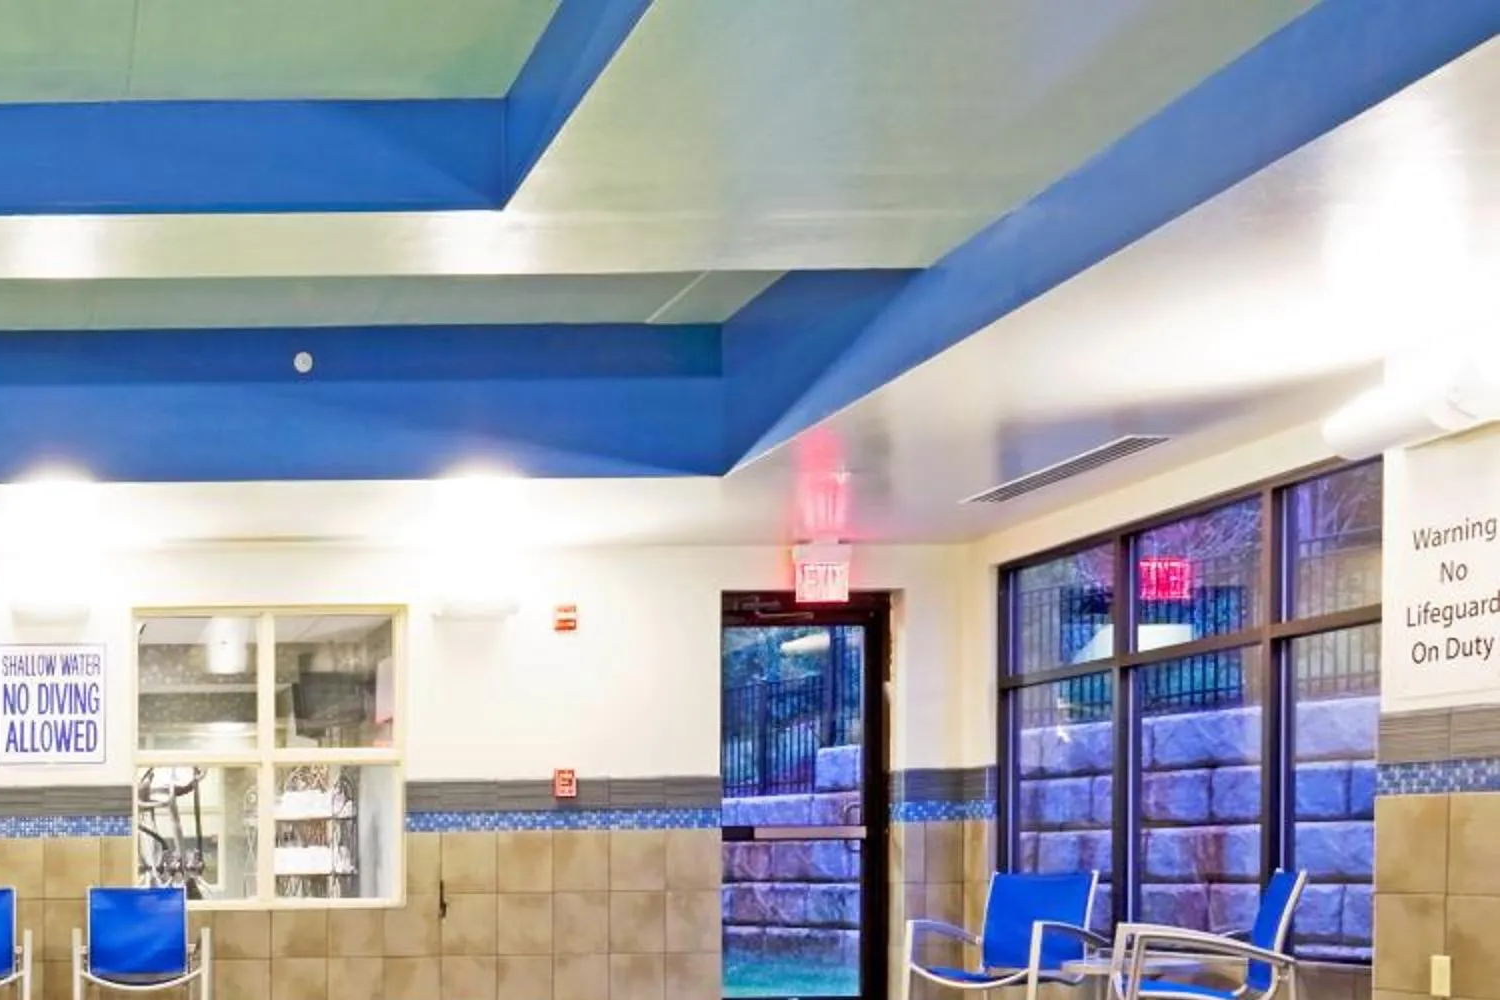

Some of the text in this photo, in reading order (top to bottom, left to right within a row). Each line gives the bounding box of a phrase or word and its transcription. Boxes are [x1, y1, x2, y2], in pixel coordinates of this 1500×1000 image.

[1412, 517, 1498, 551] Warning
[1439, 560, 1469, 584] No
[1406, 590, 1500, 629] Lifeguard
[2, 654, 100, 677] SHALLOW WATER
[1411, 636, 1495, 665] On Duty
[3, 682, 100, 715] NO DIVING
[5, 719, 98, 753] ALLOWED
